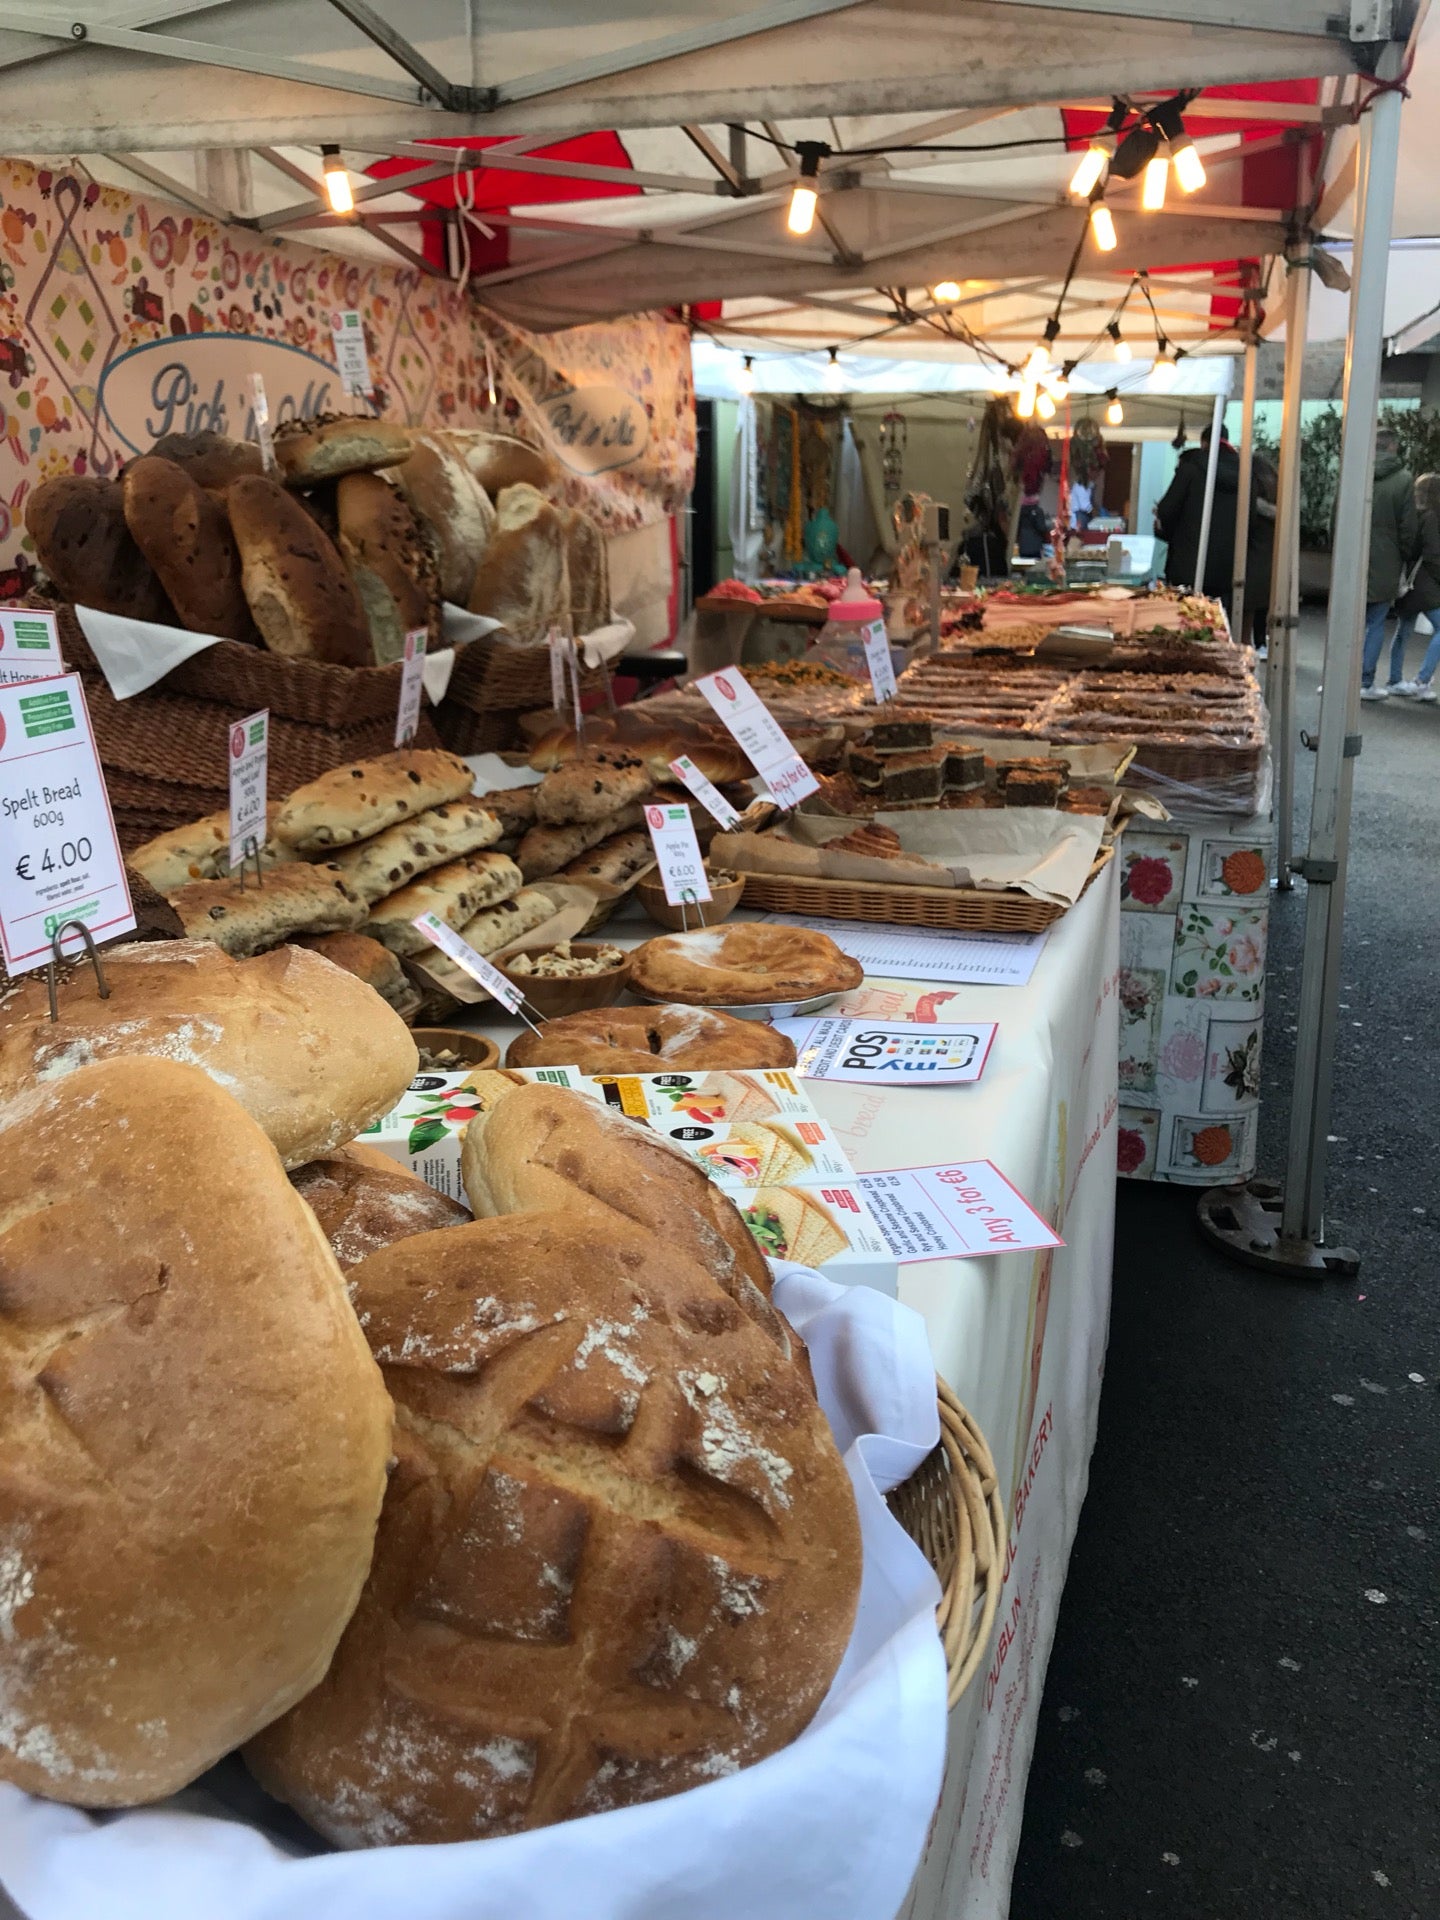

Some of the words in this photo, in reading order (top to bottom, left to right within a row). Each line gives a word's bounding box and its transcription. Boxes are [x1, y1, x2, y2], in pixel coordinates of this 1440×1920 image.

[3, 788, 40, 819] Spelt
[42, 777, 82, 800] Bread
[33, 810, 65, 828] 600g
[41, 837, 92, 873] 4.00
[842, 1033, 888, 1070] POS
[877, 1059, 938, 1071] my
[660, 1075, 672, 1086] FREE
[682, 1128, 695, 1140] FREE
[935, 1169, 969, 1185] €6
[954, 1186, 987, 1205] for
[965, 1206, 995, 1215] 3
[979, 1217, 1021, 1243] Any
[1014, 1402, 1053, 1534] BAKERY
[982, 1584, 1021, 1713] DUBLIN
